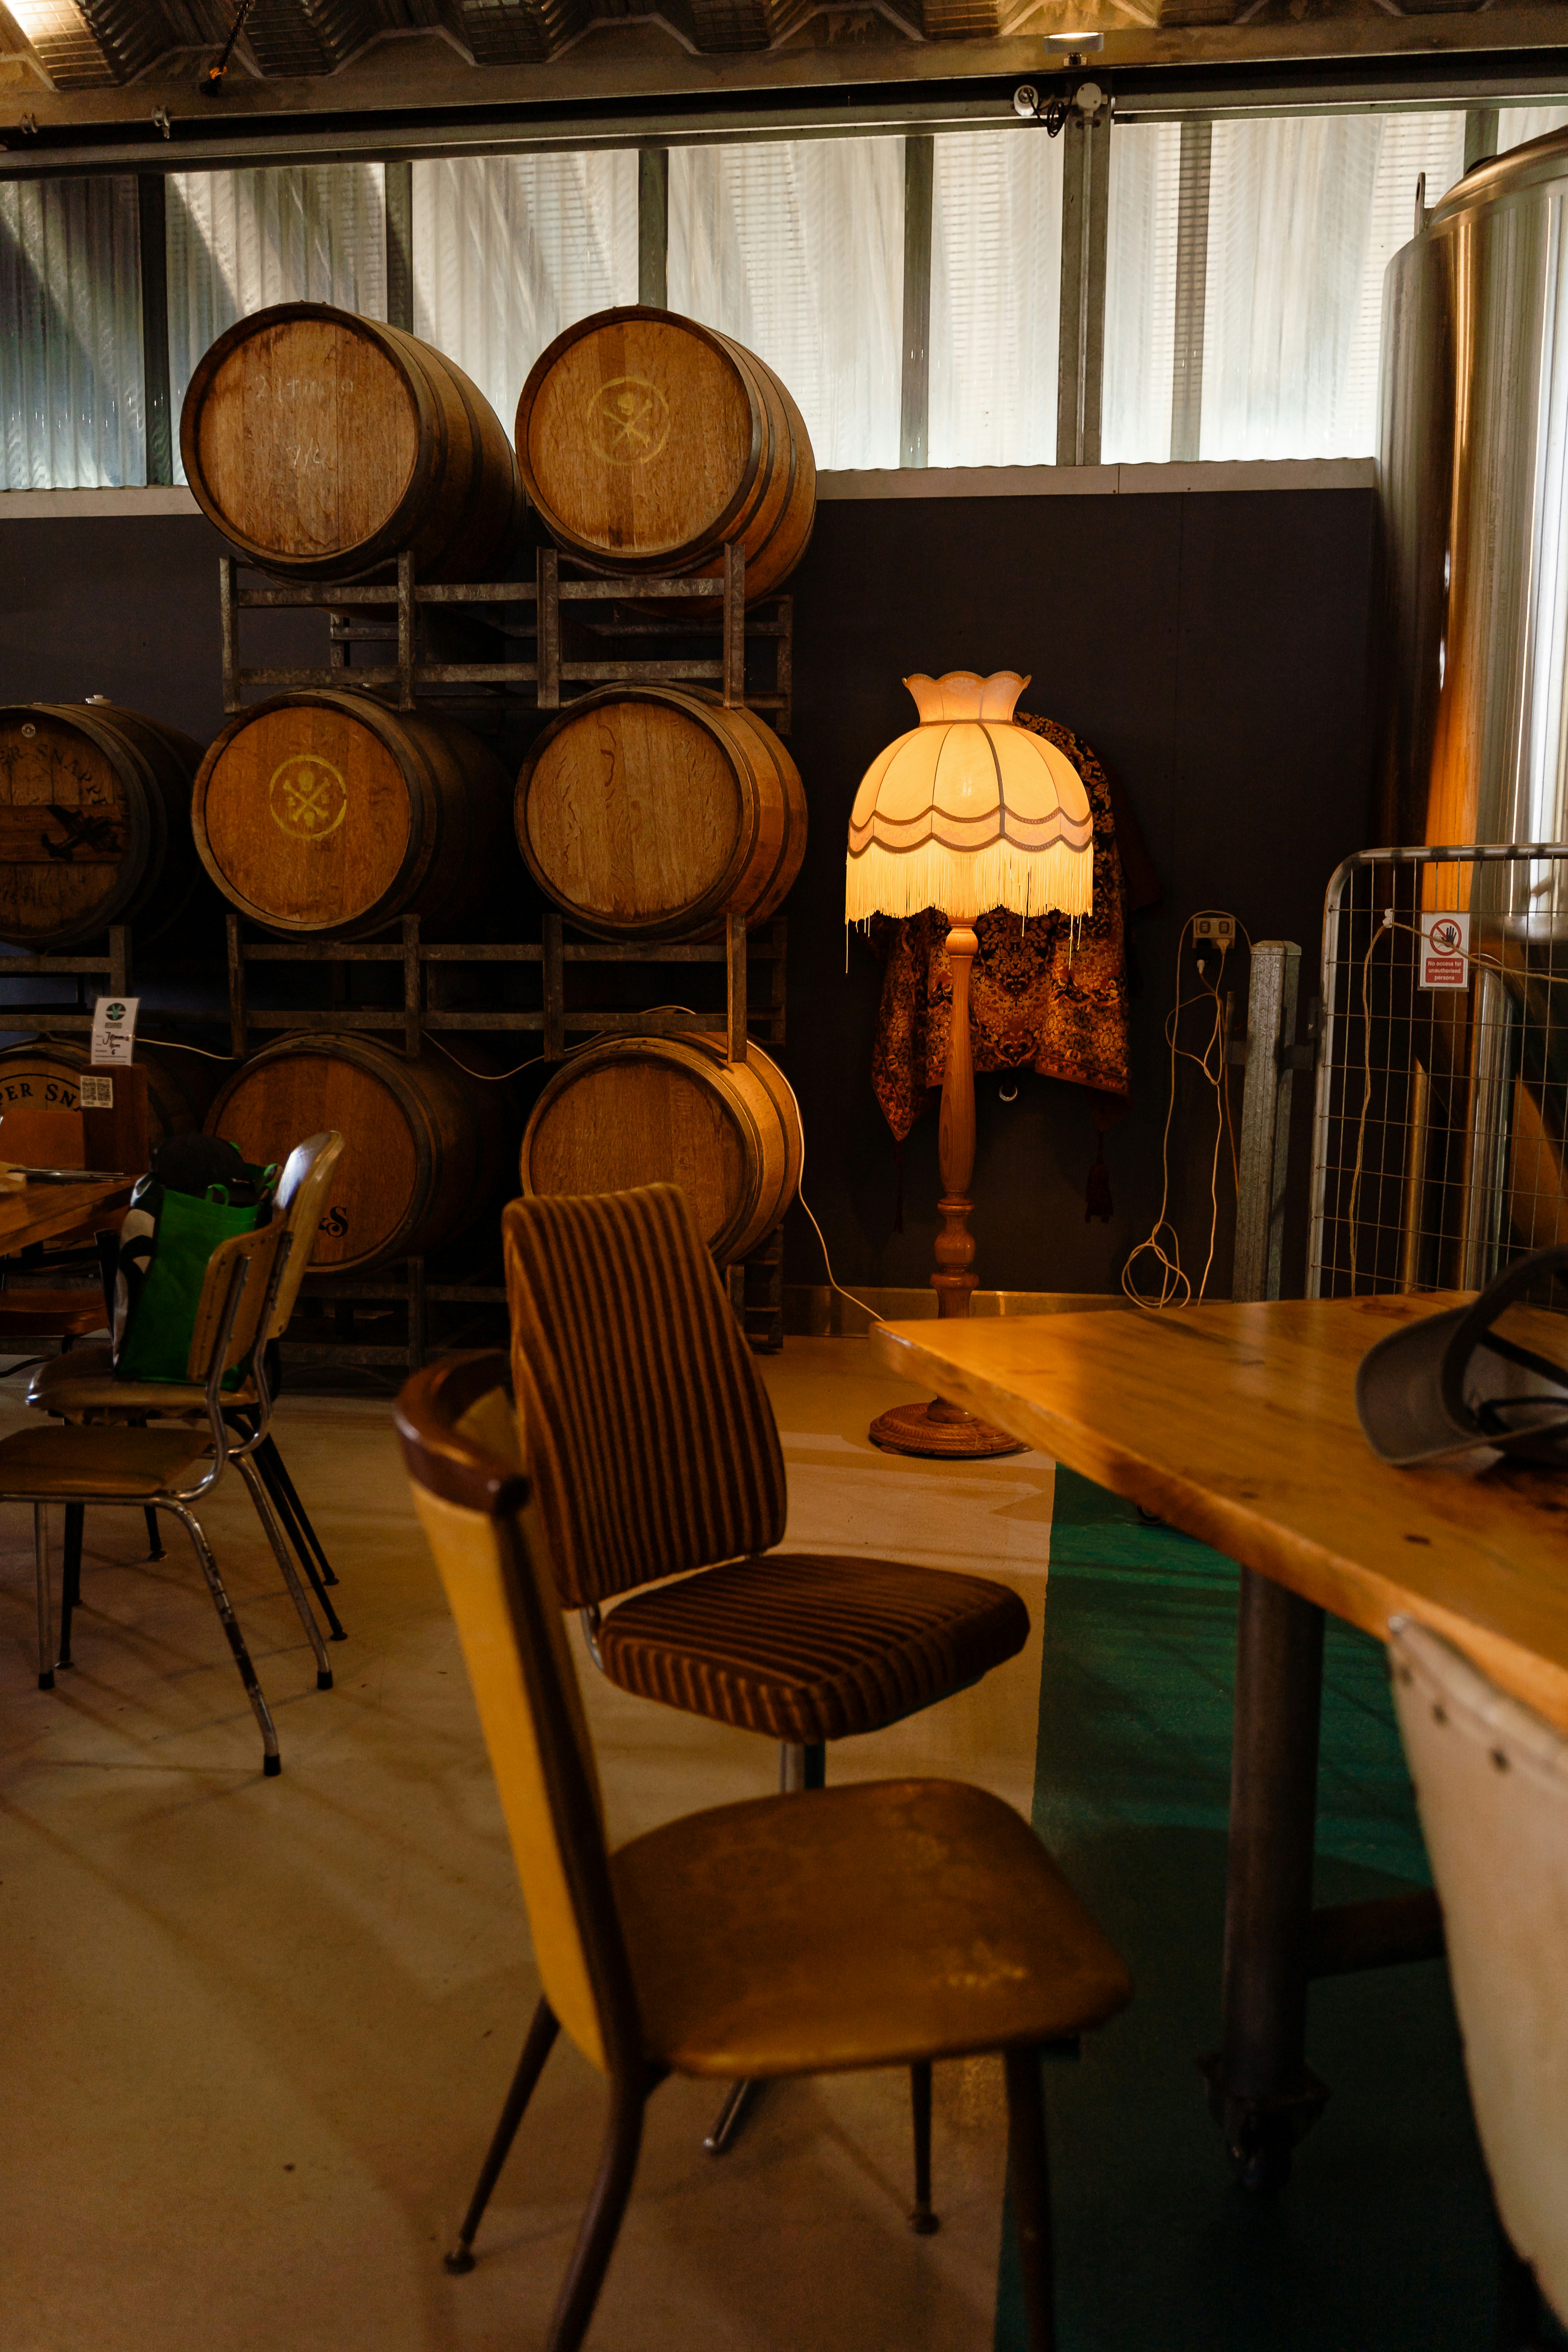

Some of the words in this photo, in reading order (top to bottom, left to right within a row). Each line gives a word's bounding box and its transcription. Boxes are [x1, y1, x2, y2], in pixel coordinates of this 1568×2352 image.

[103, 1032, 129, 1045] Jemma
[0, 1083, 33, 1106] ER
[45, 1083, 82, 1112] SN
[318, 1206, 348, 1237] S
